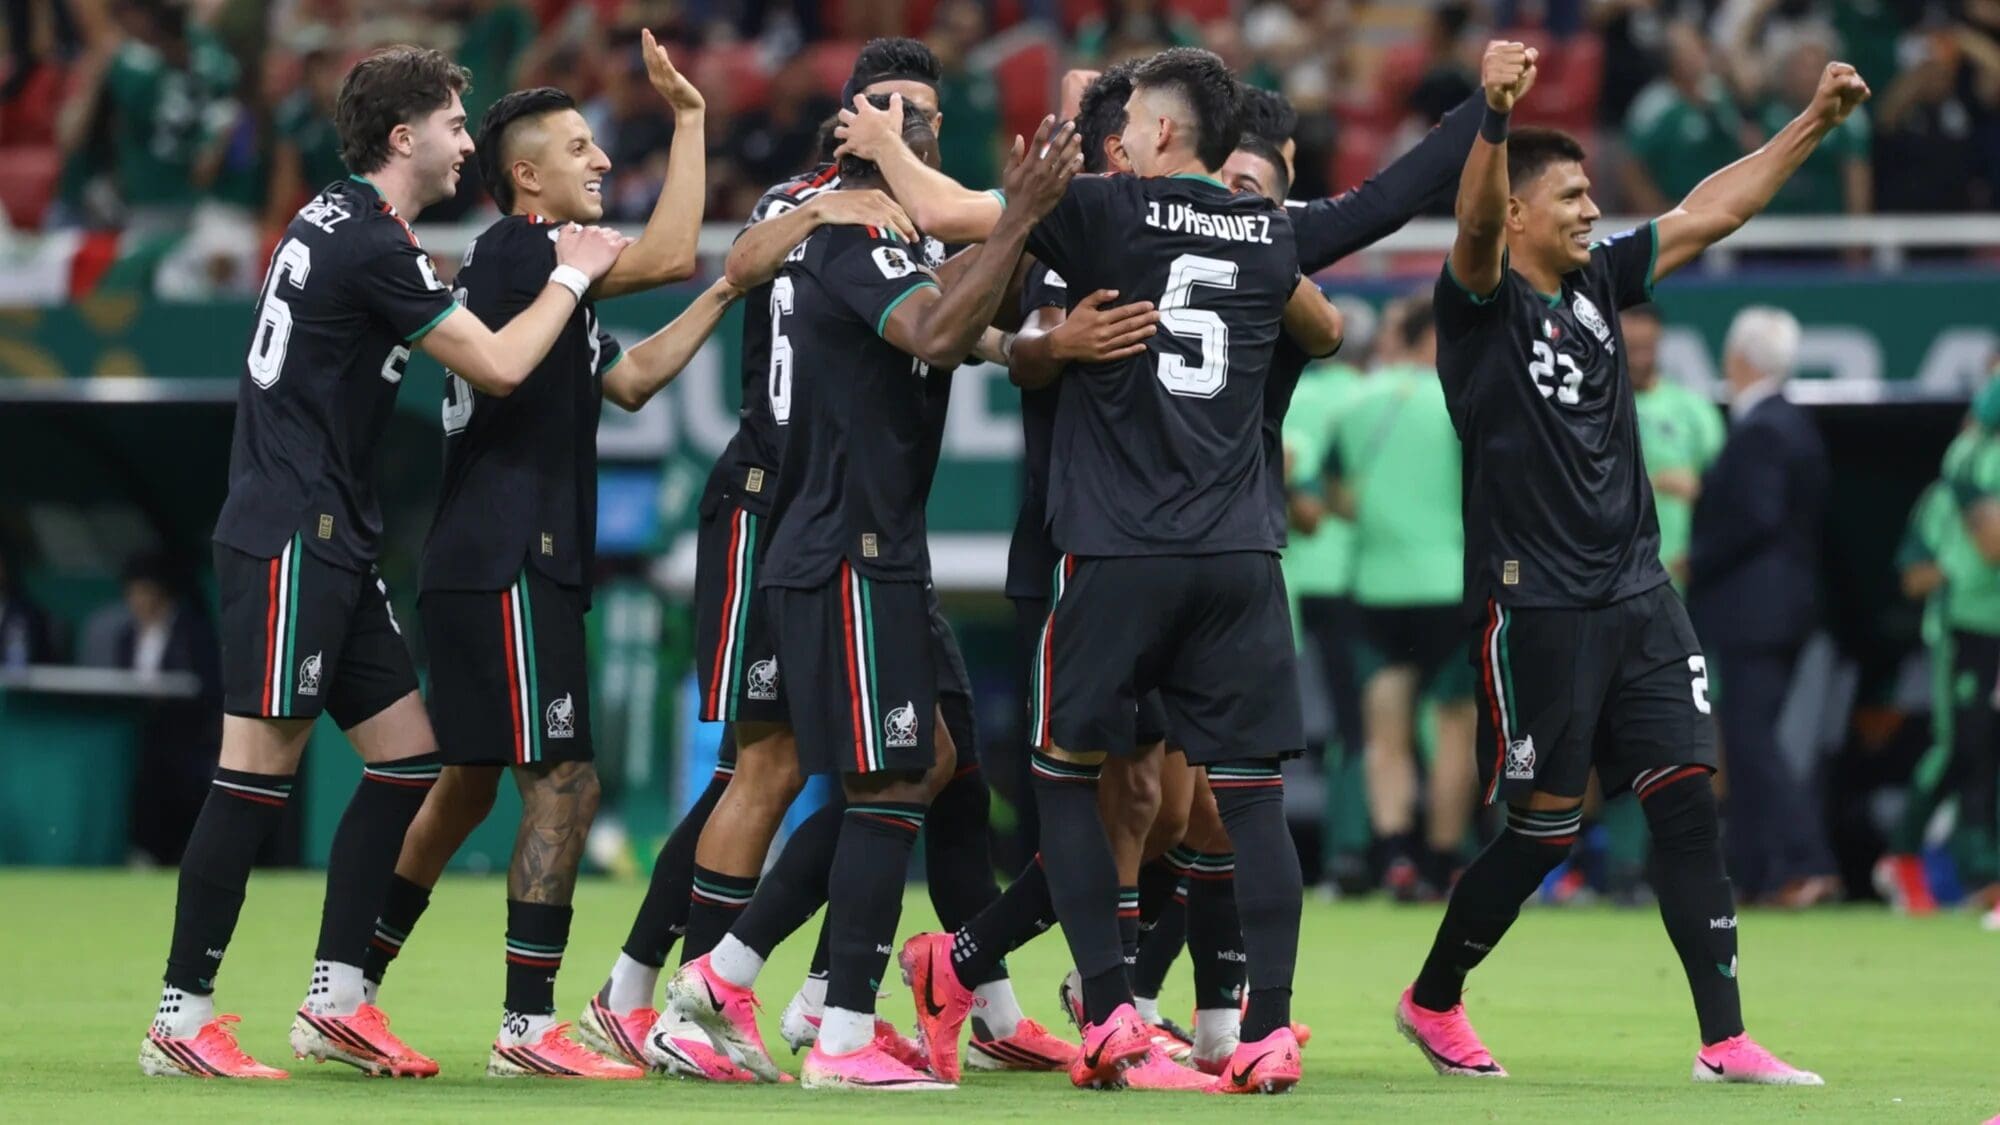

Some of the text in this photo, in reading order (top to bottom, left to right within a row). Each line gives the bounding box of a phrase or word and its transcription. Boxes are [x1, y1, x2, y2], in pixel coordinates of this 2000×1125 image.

[1145, 201, 1274, 245] J.VÁSQUEZ
[248, 237, 311, 390] 6
[769, 275, 795, 426] 6
[1156, 253, 1240, 399] 5
[1528, 340, 1584, 405] 23
